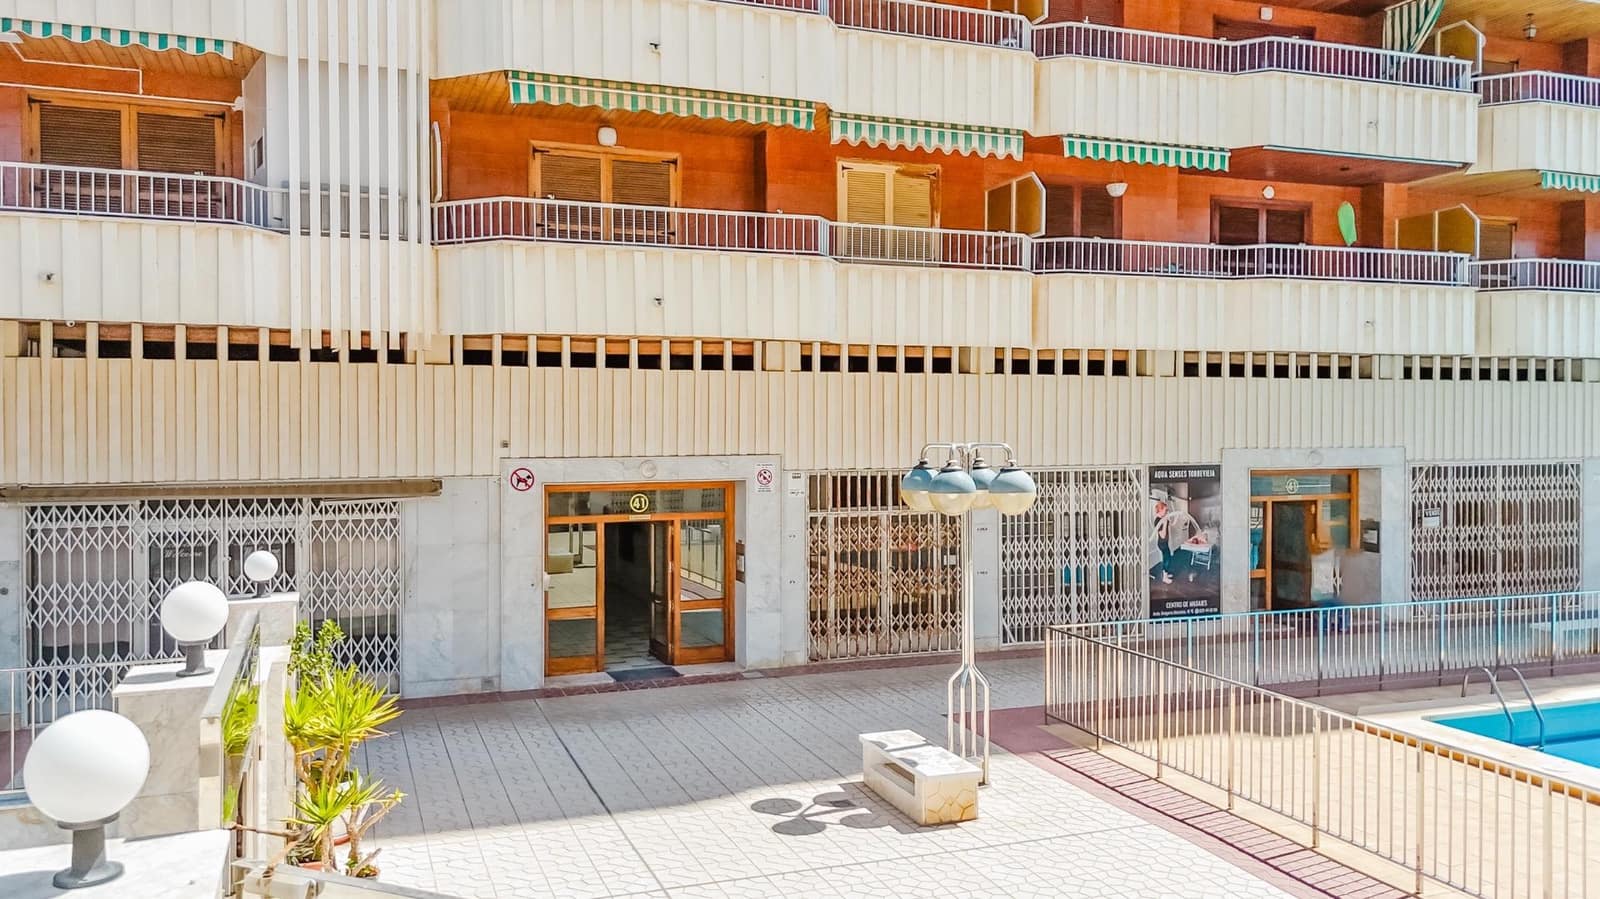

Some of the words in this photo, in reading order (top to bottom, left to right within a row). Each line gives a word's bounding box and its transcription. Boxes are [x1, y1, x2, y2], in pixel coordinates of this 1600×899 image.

[1154, 470, 1168, 478] AQUA
[1169, 470, 1187, 478] SENSES
[633, 498, 645, 508] 41
[1165, 601, 1182, 609] CENTRO
